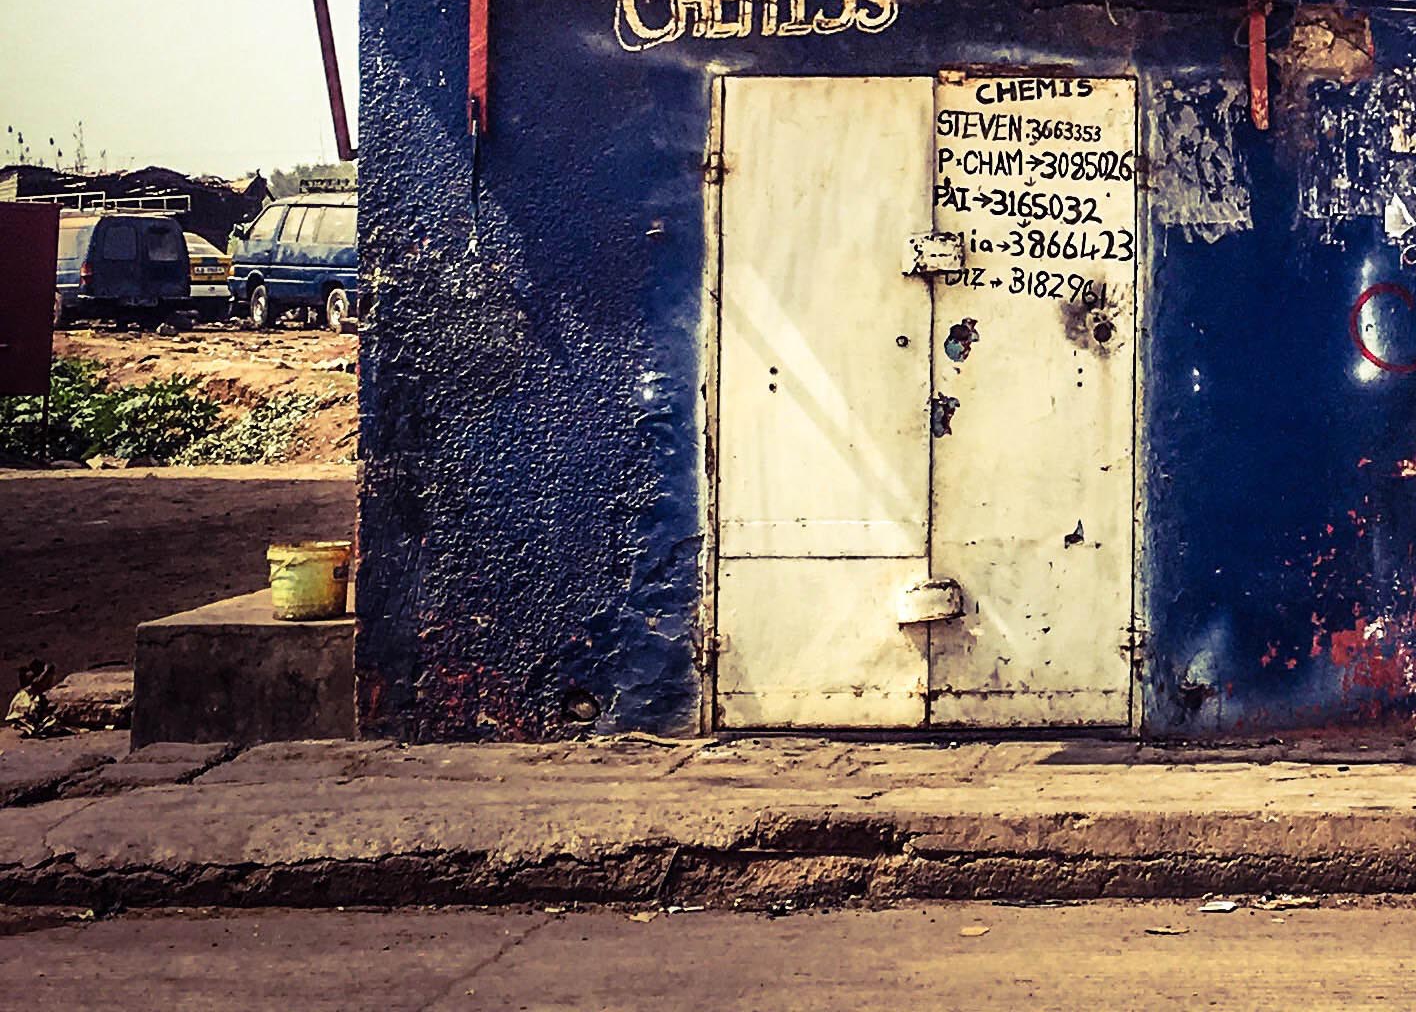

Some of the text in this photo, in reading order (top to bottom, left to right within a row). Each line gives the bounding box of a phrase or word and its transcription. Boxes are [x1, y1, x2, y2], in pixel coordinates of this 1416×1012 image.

[975, 78, 1094, 105] CHEMIS
[1040, 149, 1135, 181] 3085026
[990, 189, 1102, 225] 3165032
[1009, 228, 1135, 261] 3866423
